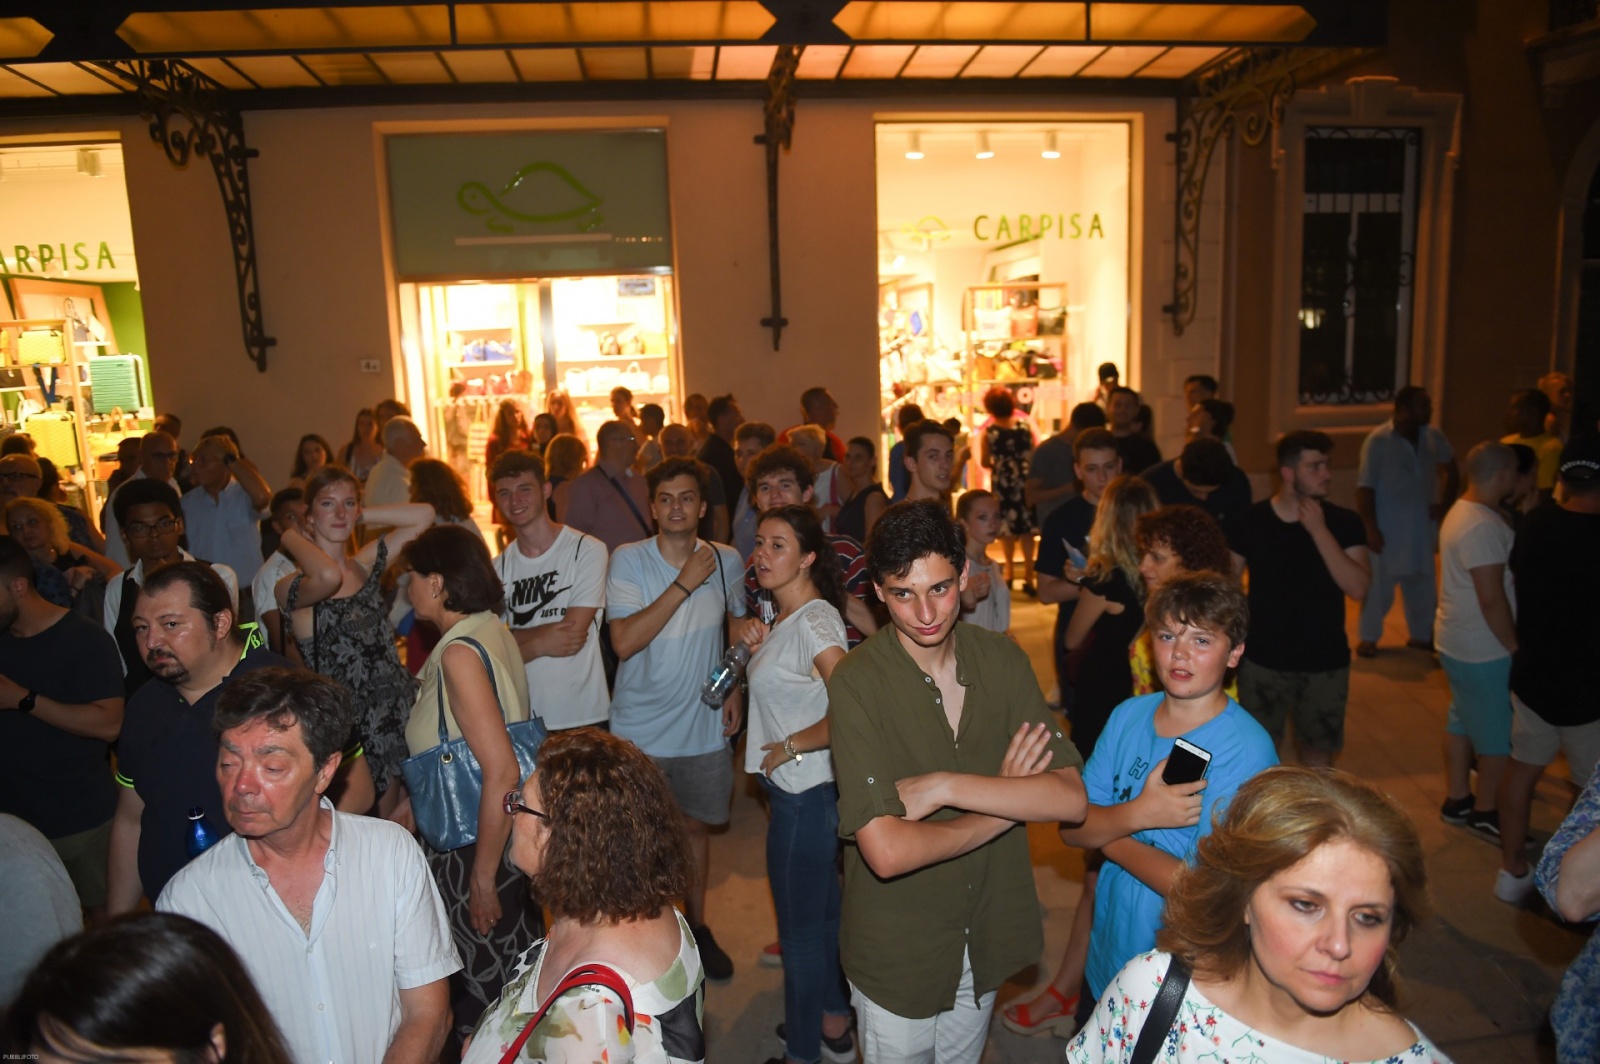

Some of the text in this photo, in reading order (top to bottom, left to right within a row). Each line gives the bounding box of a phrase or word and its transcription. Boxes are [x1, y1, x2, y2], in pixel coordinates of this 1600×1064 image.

[973, 213, 1105, 241] CARPISA
[511, 570, 560, 607] NIKE
[540, 607, 559, 619] JUST
